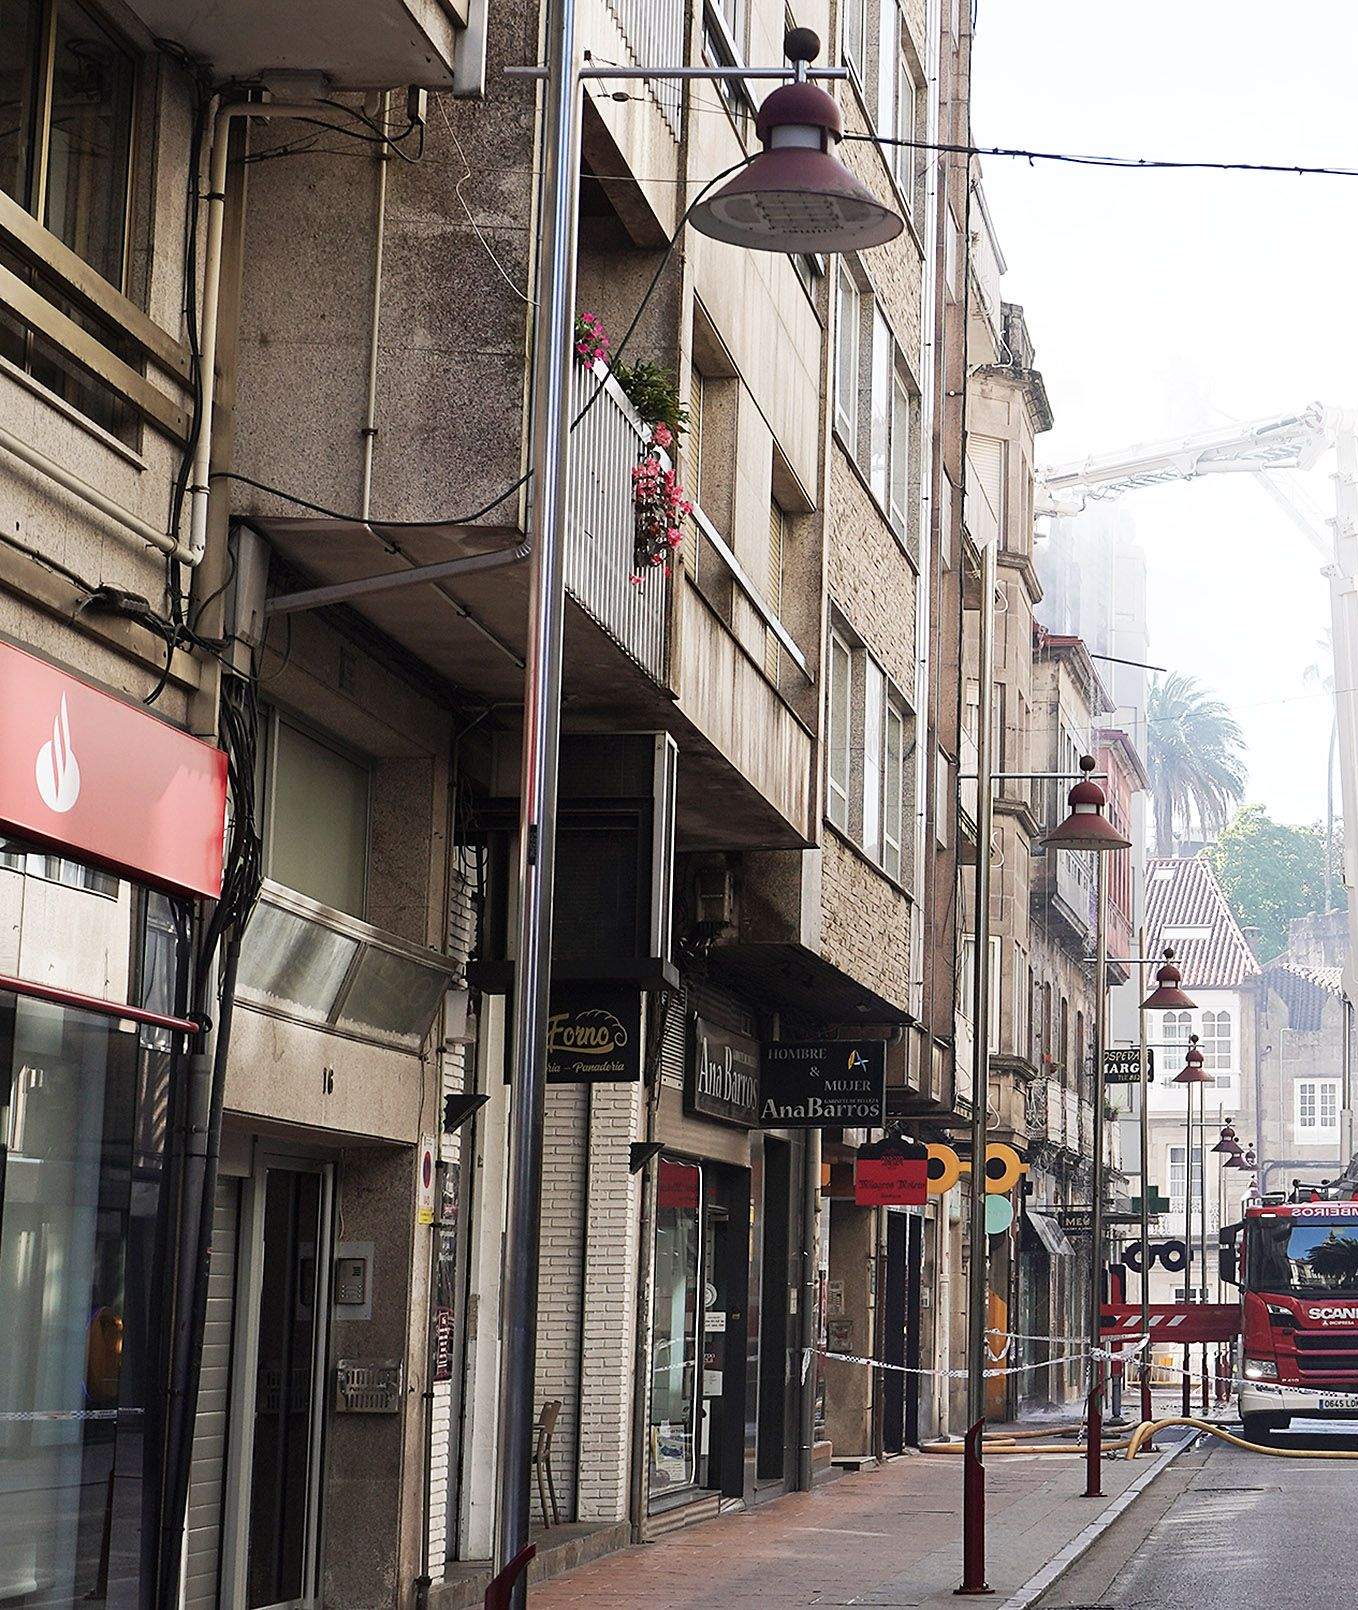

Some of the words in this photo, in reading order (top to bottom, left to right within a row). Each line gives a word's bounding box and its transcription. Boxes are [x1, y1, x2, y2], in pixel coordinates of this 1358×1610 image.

[547, 1012, 612, 1053] Forno
[768, 1047, 827, 1061] HOMBRE
[808, 1066, 821, 1078] &
[824, 1079, 872, 1092] MUJER
